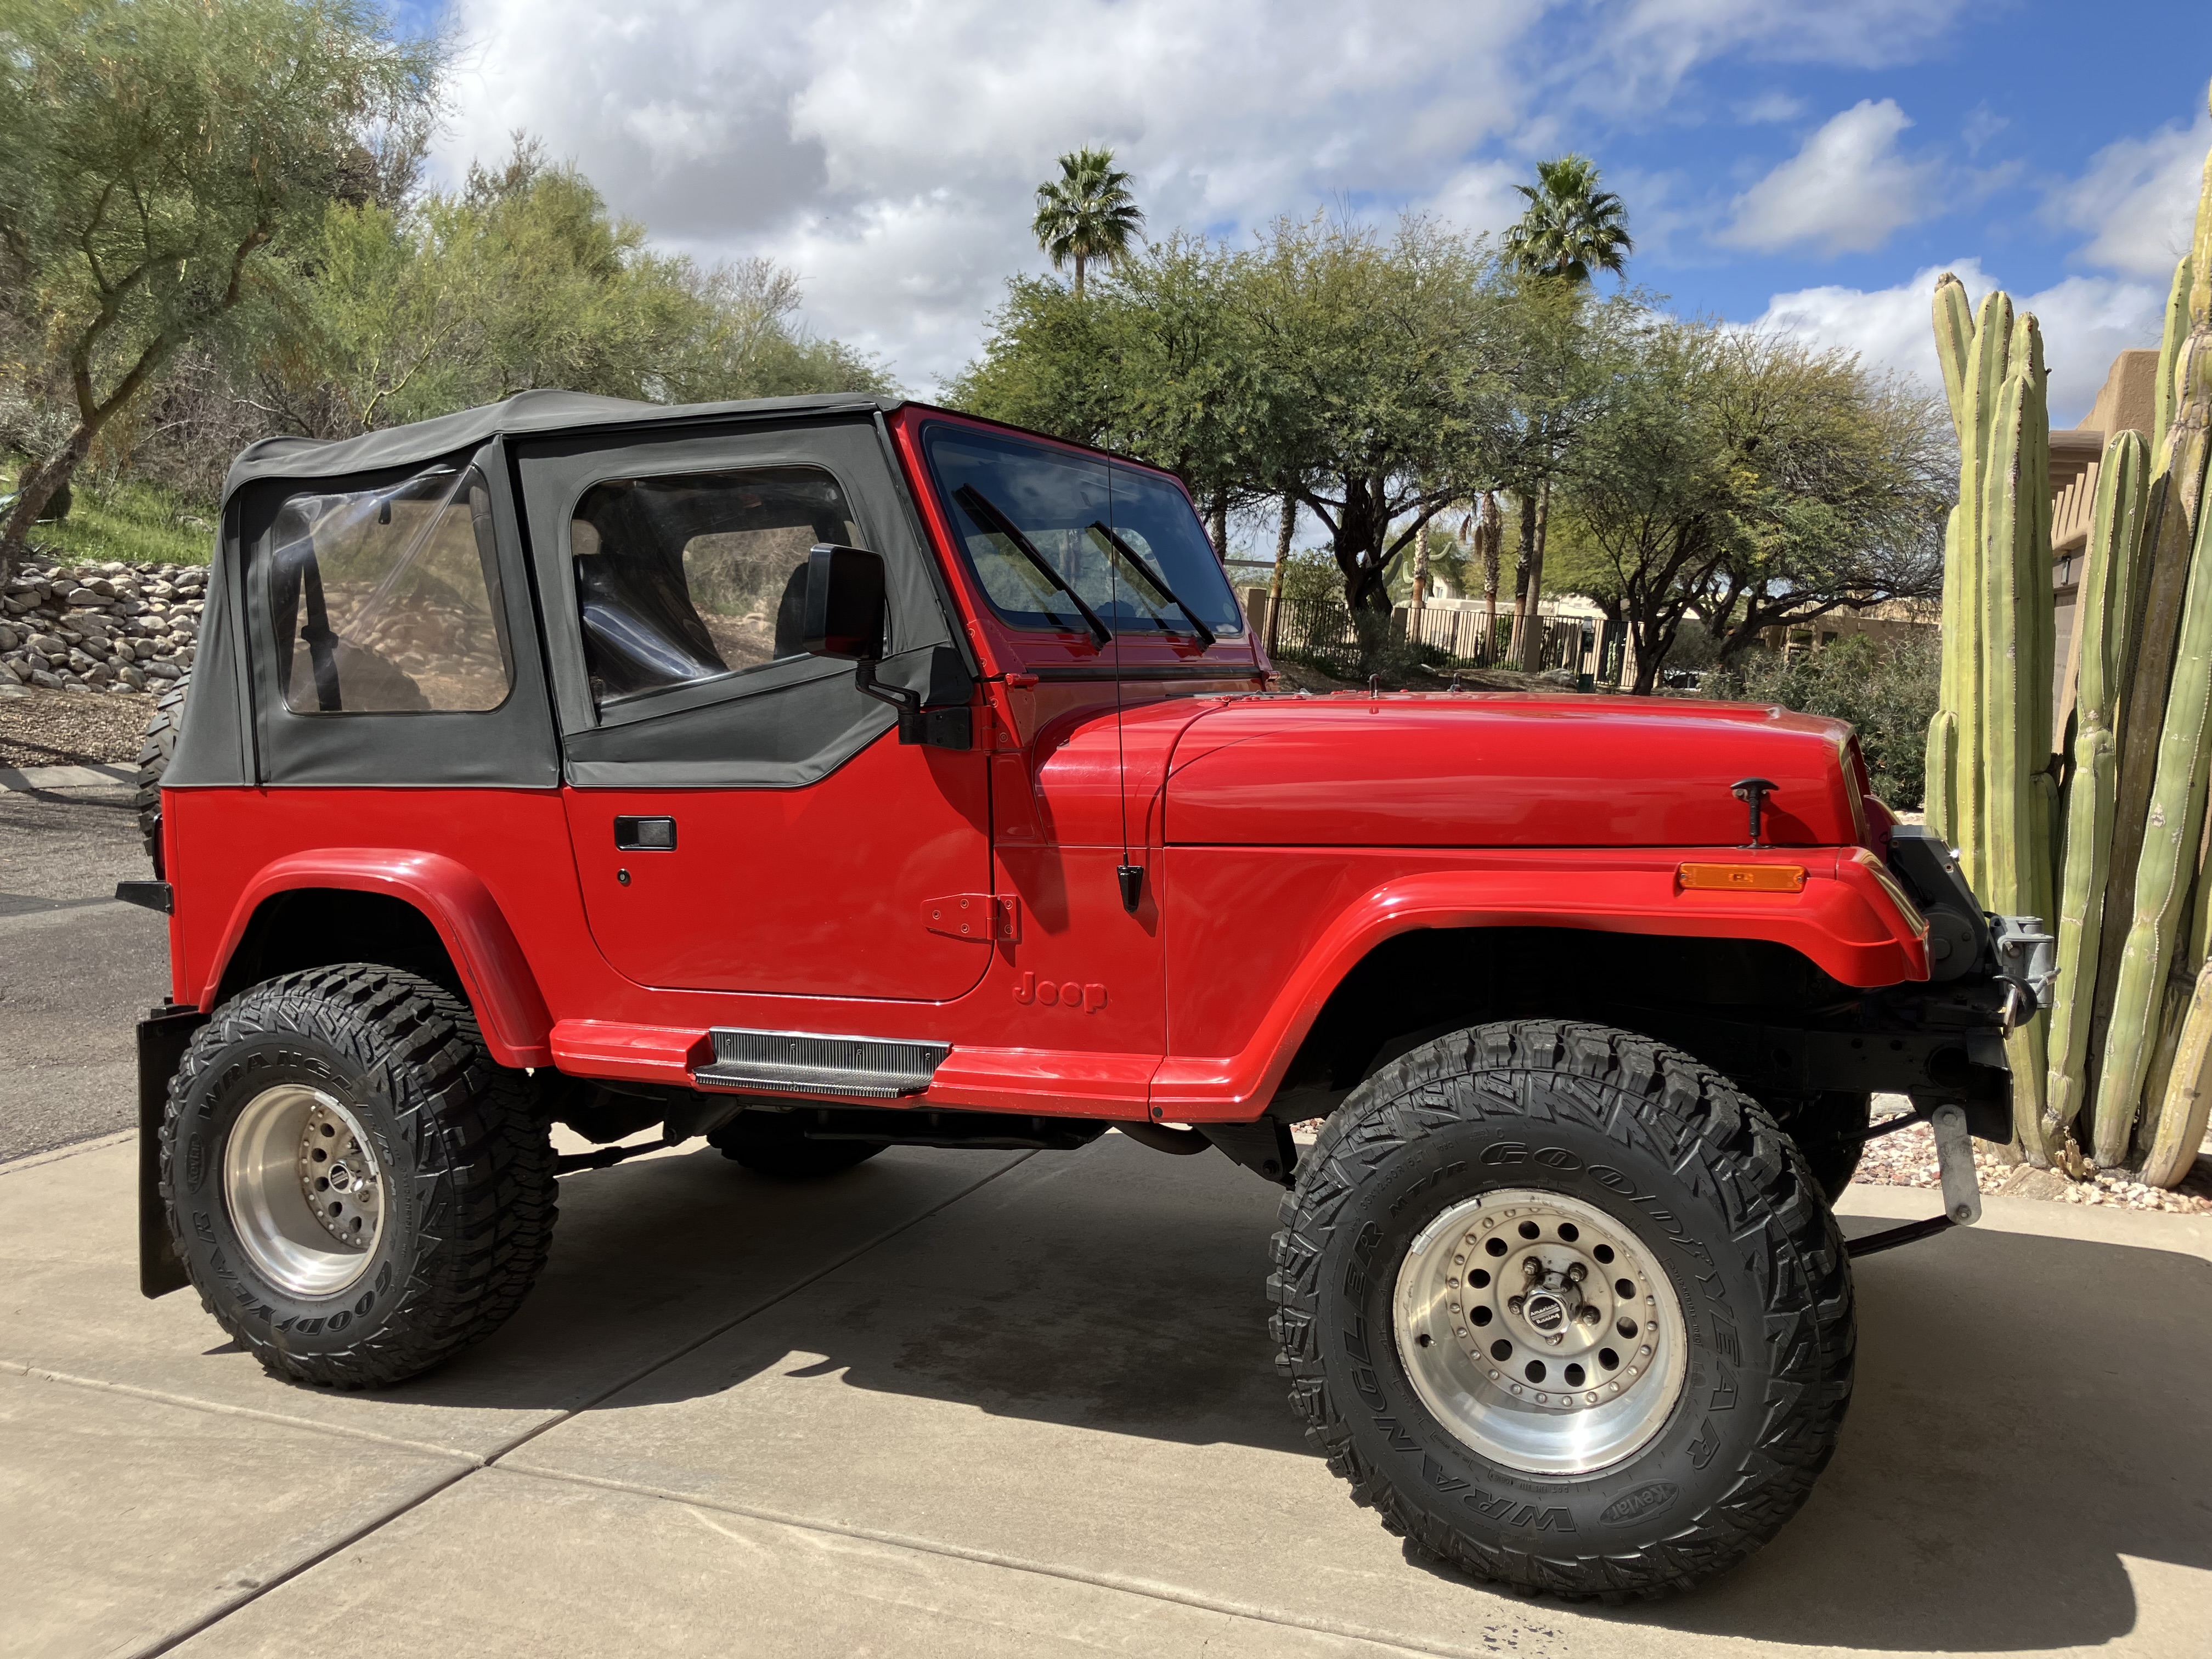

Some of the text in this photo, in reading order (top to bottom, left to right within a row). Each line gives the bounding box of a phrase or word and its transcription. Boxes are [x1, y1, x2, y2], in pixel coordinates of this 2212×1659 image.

[193, 1210, 392, 1335] GOODYEAR
[1479, 1141, 1741, 1470] GOODYEAR
[1530, 1303, 1559, 1316] American
[1536, 1313, 1560, 1324] Racing
[1342, 1220, 1578, 1534] WRANGLER
[1611, 1485, 1669, 1520] Kevlar
